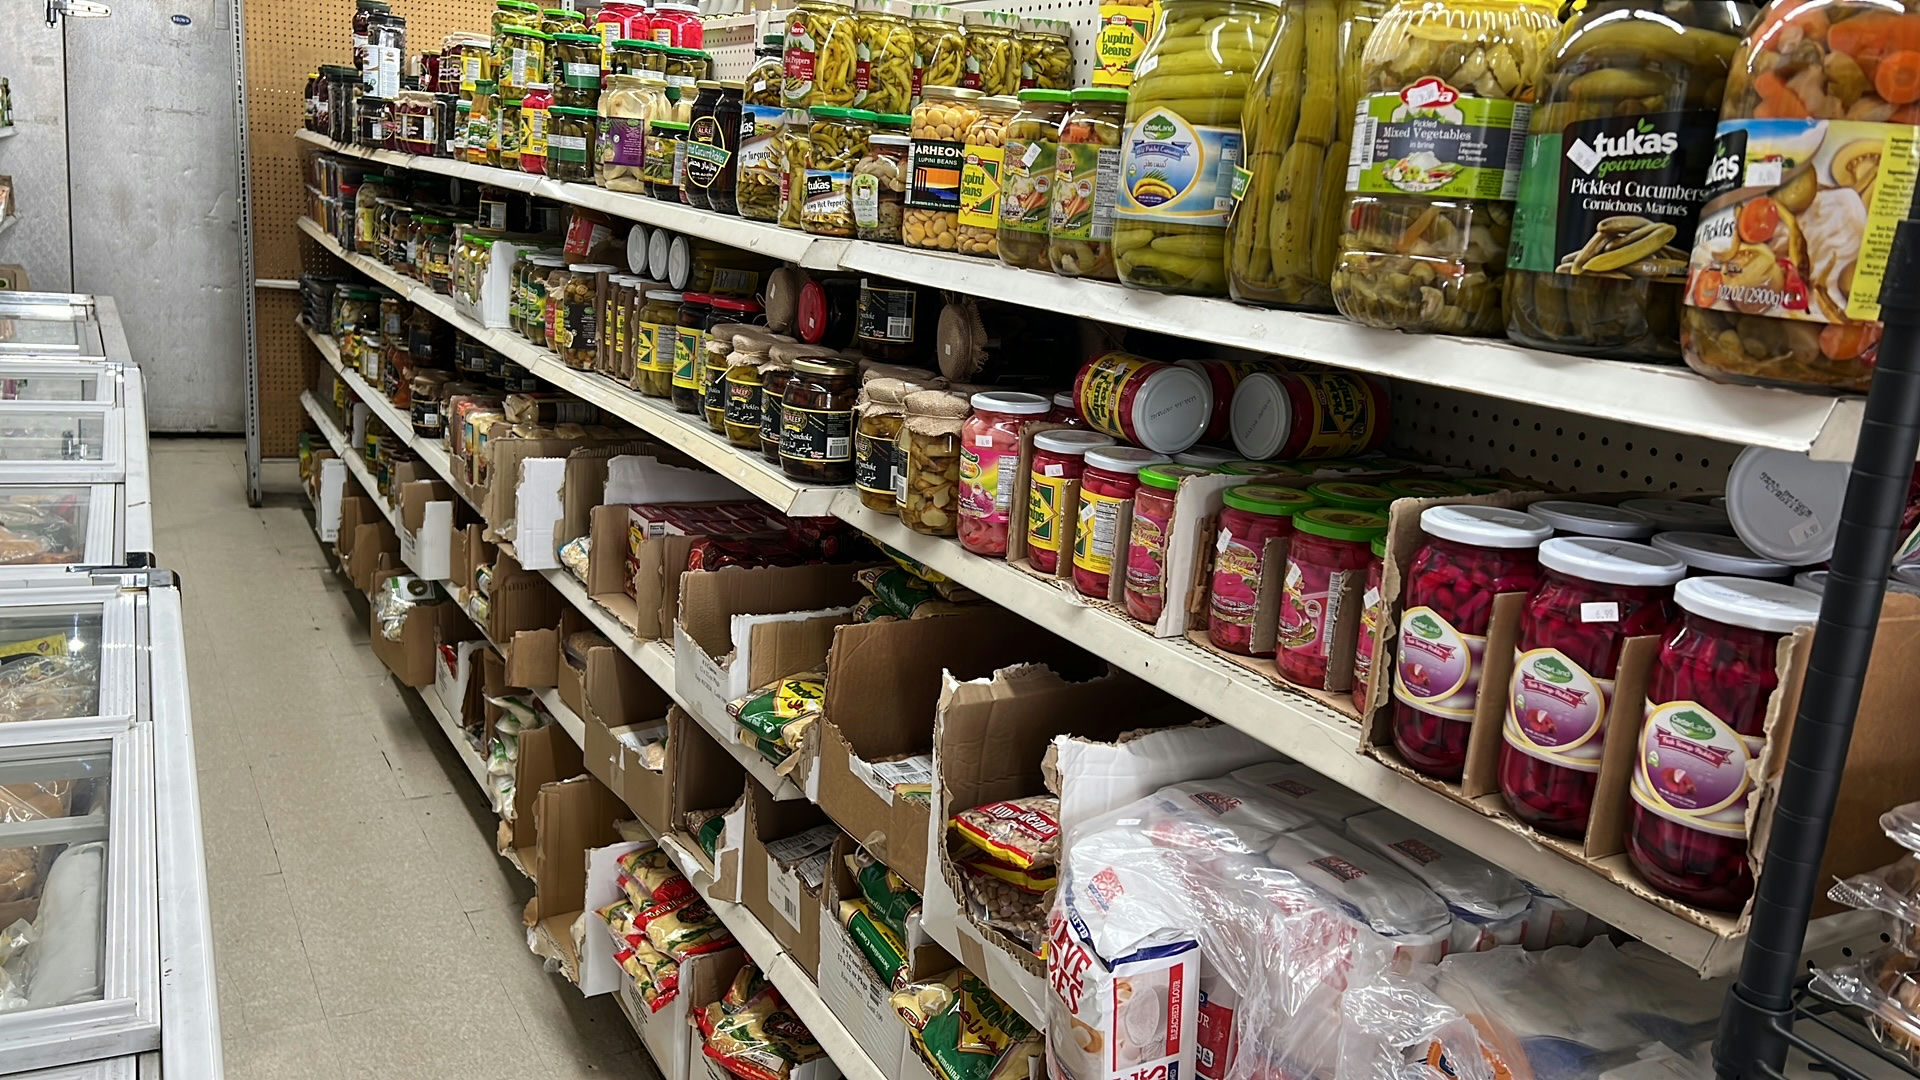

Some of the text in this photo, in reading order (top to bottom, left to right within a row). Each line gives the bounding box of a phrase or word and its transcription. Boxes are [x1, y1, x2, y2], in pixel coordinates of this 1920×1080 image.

[1102, 31, 1135, 46] Lupini
[1101, 43, 1131, 57] Beans
[1383, 126, 1472, 140] Mixed Vegetables
[1413, 120, 1438, 129] Pickled
[1417, 140, 1435, 149] brine
[937, 158, 958, 166] BEANS
[1598, 154, 1671, 178] gourmet
[1570, 178, 1708, 202] Pickled Cucumbers
[827, 200, 848, 208] Peppers
[1582, 198, 1688, 217] Cornichons Marinés
[1702, 218, 1735, 244] Pickles
[1018, 811, 1058, 835] Beans
[1172, 979, 1180, 1004] FLOUR
[1170, 1004, 1180, 1041] BLEACHED
[935, 1049, 960, 1080] Semolina
